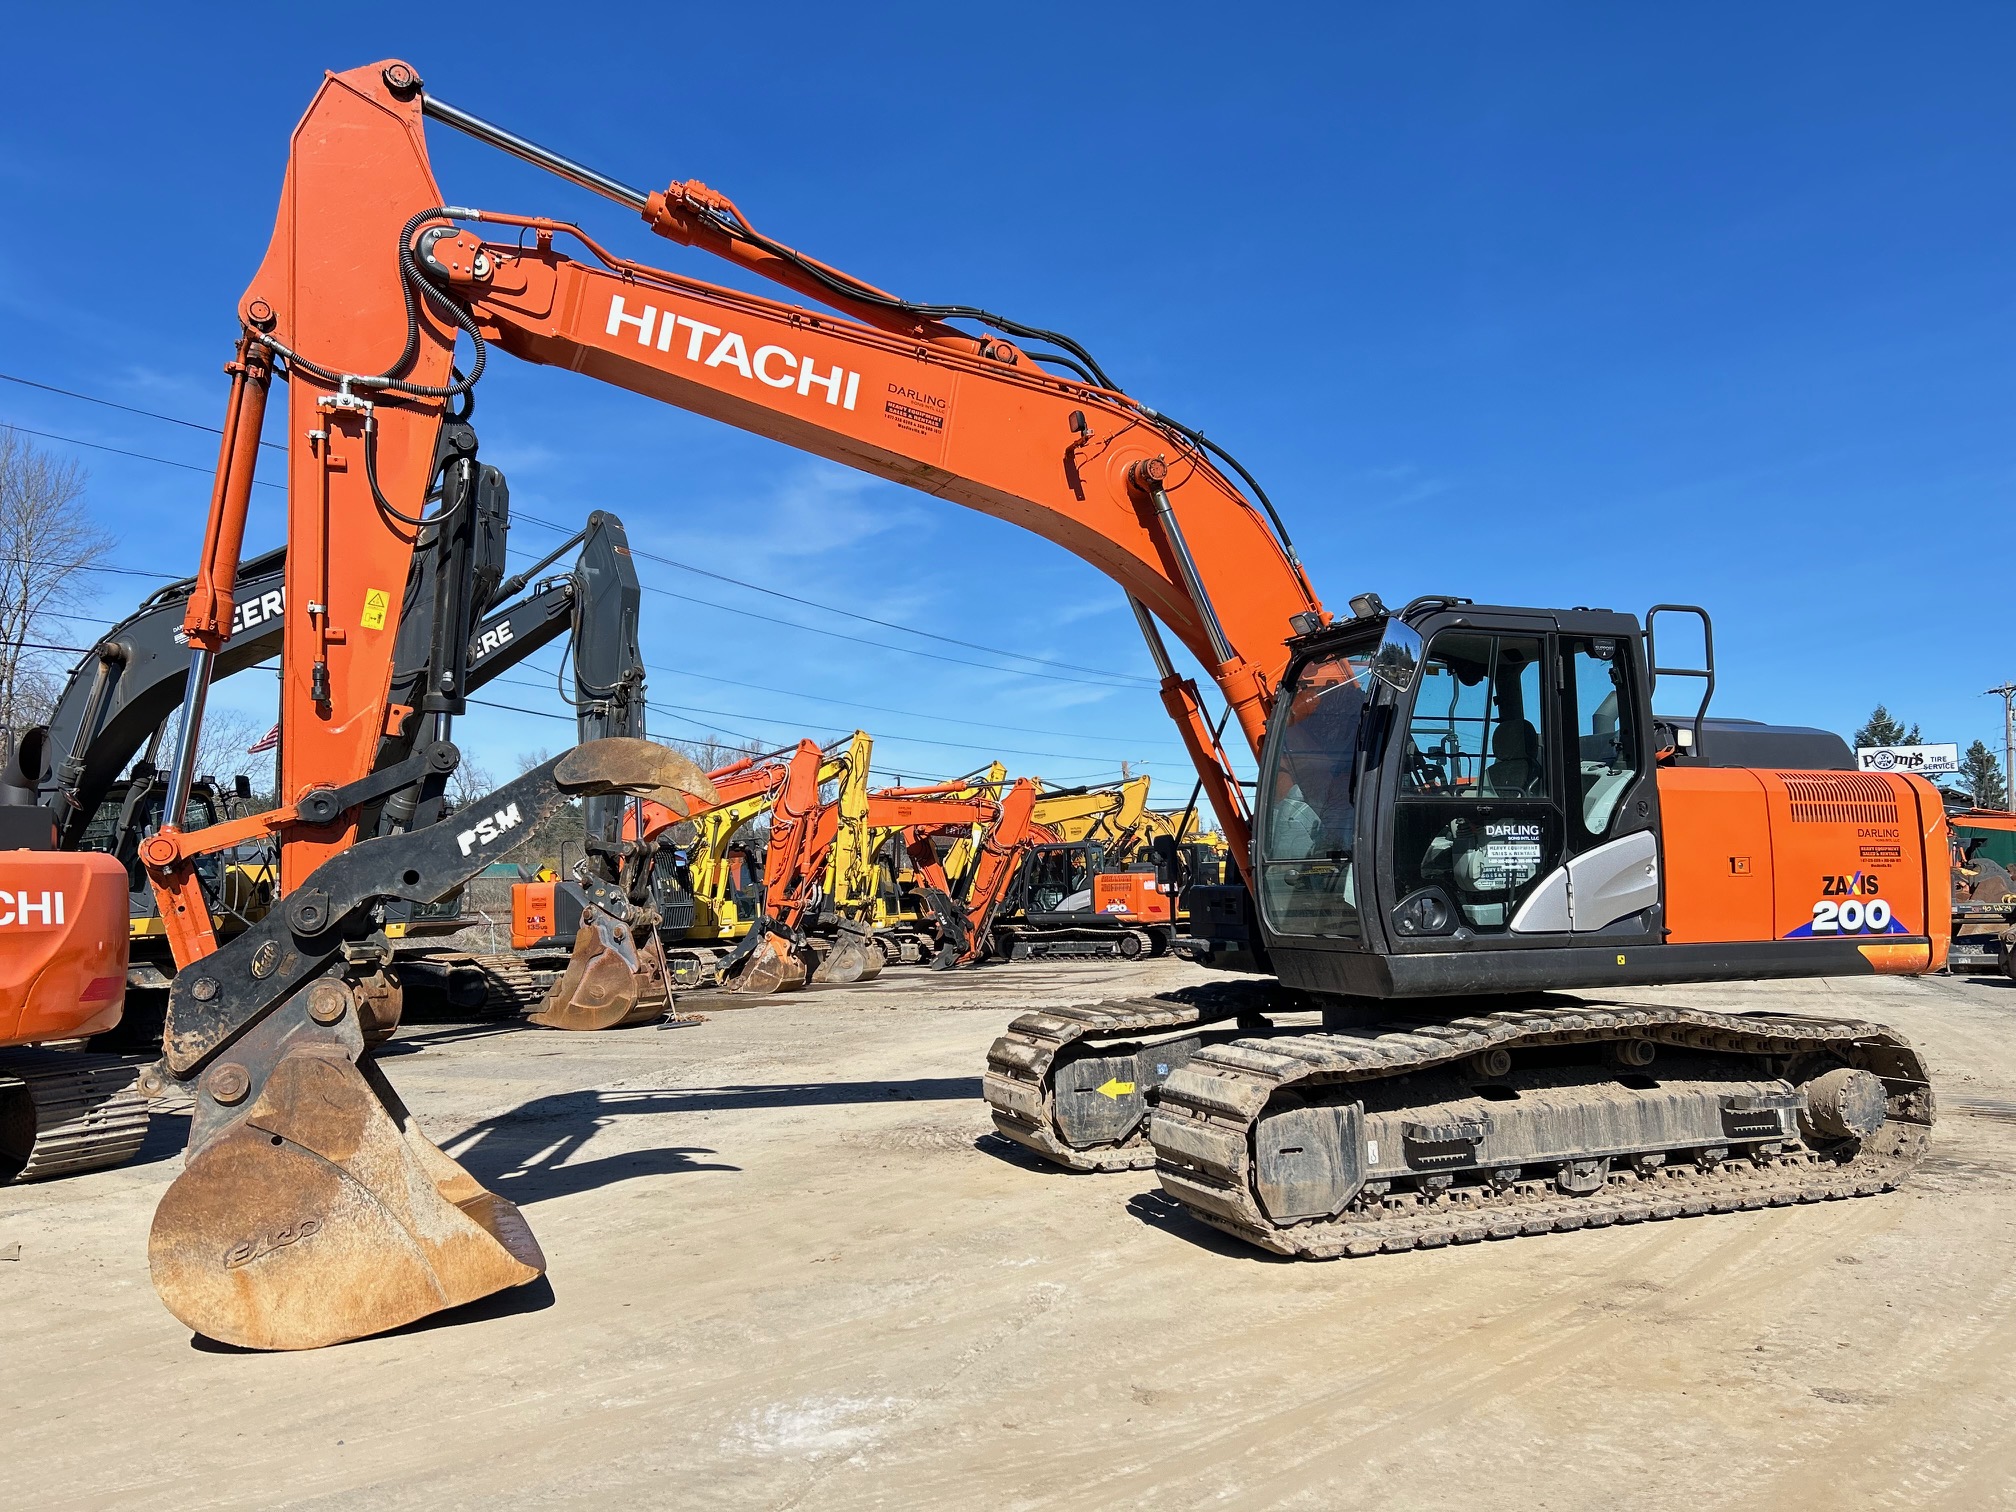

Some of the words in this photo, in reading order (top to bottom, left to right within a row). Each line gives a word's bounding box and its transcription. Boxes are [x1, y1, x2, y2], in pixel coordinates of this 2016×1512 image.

[605, 294, 861, 411] HITACHI
[887, 382, 946, 409] DARLING
[1923, 762, 1956, 771] SERVICE
[1486, 825, 1540, 836] DARLING
[1857, 828, 1900, 838] DARLING
[1822, 871, 1879, 896] ZAXIS
[1105, 903, 1128, 913] 120
[526, 915, 546, 923] ZAXIS
[1811, 898, 1891, 935] 200
